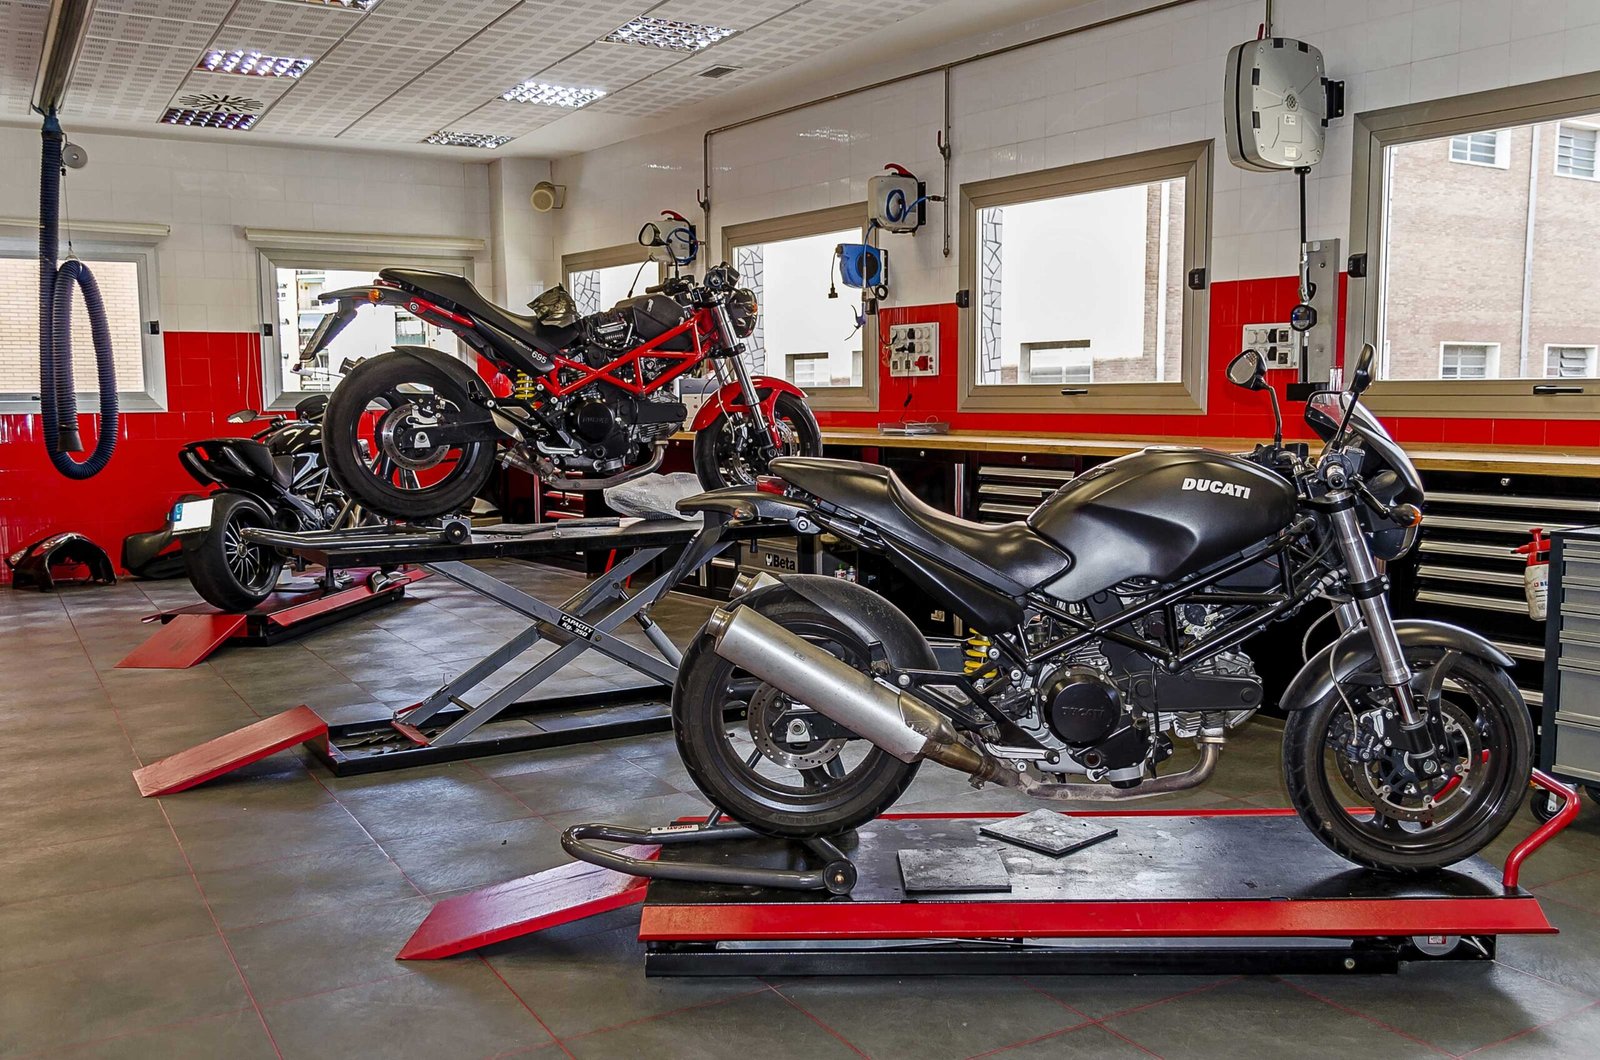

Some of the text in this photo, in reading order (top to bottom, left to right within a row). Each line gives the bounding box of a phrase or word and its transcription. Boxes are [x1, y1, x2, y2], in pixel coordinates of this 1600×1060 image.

[532, 351, 547, 364] 695
[1182, 478, 1250, 499] DUCATI
[773, 553, 796, 571] Beta
[561, 615, 594, 634] CAPACITY
[573, 627, 588, 637] 350
